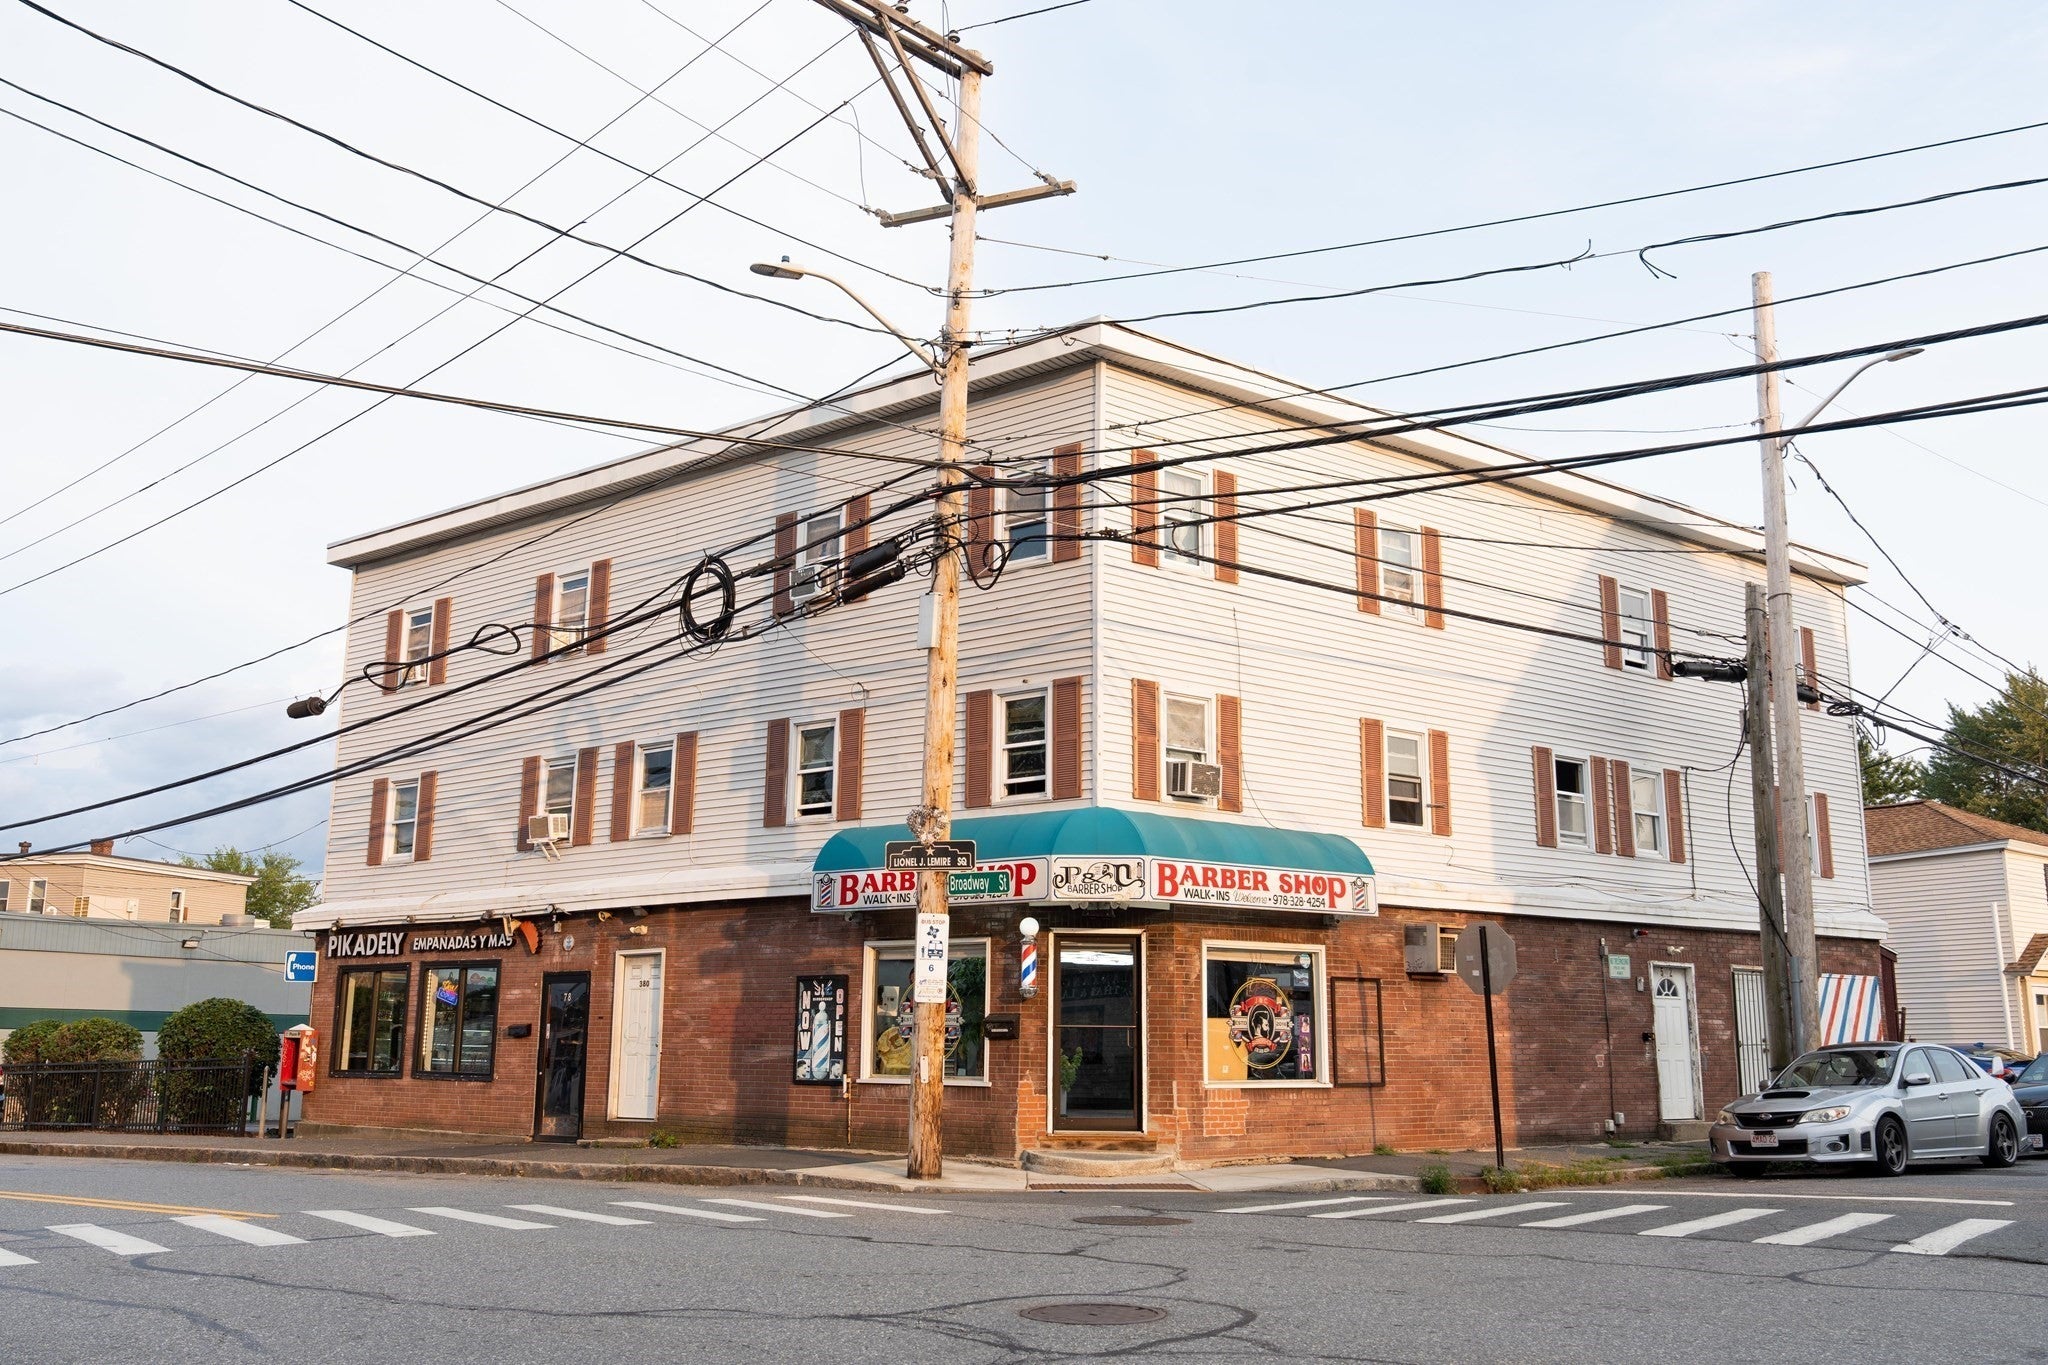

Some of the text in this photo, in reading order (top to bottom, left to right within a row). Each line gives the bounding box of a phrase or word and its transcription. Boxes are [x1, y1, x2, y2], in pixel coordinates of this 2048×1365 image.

[893, 857, 918, 868] LIONEL
[927, 856, 951, 867] LEMIRE
[957, 856, 968, 867] SQ
[838, 870, 917, 906] BARB
[950, 875, 990, 893] Broadway
[998, 874, 1007, 891] St
[1157, 862, 1347, 909] BARBER SHOP
[863, 893, 911, 905] WALK-INS
[1184, 888, 1230, 901] WALK-INS
[327, 932, 405, 958] PIKADELY
[413, 935, 477, 951] EMPANADAS
[479, 935, 486, 949] Y
[292, 963, 315, 971] Phone
[928, 964, 934, 972] 6
[639, 980, 650, 988] 380
[800, 990, 811, 1051] NOW
[834, 988, 844, 1052] OPEN
